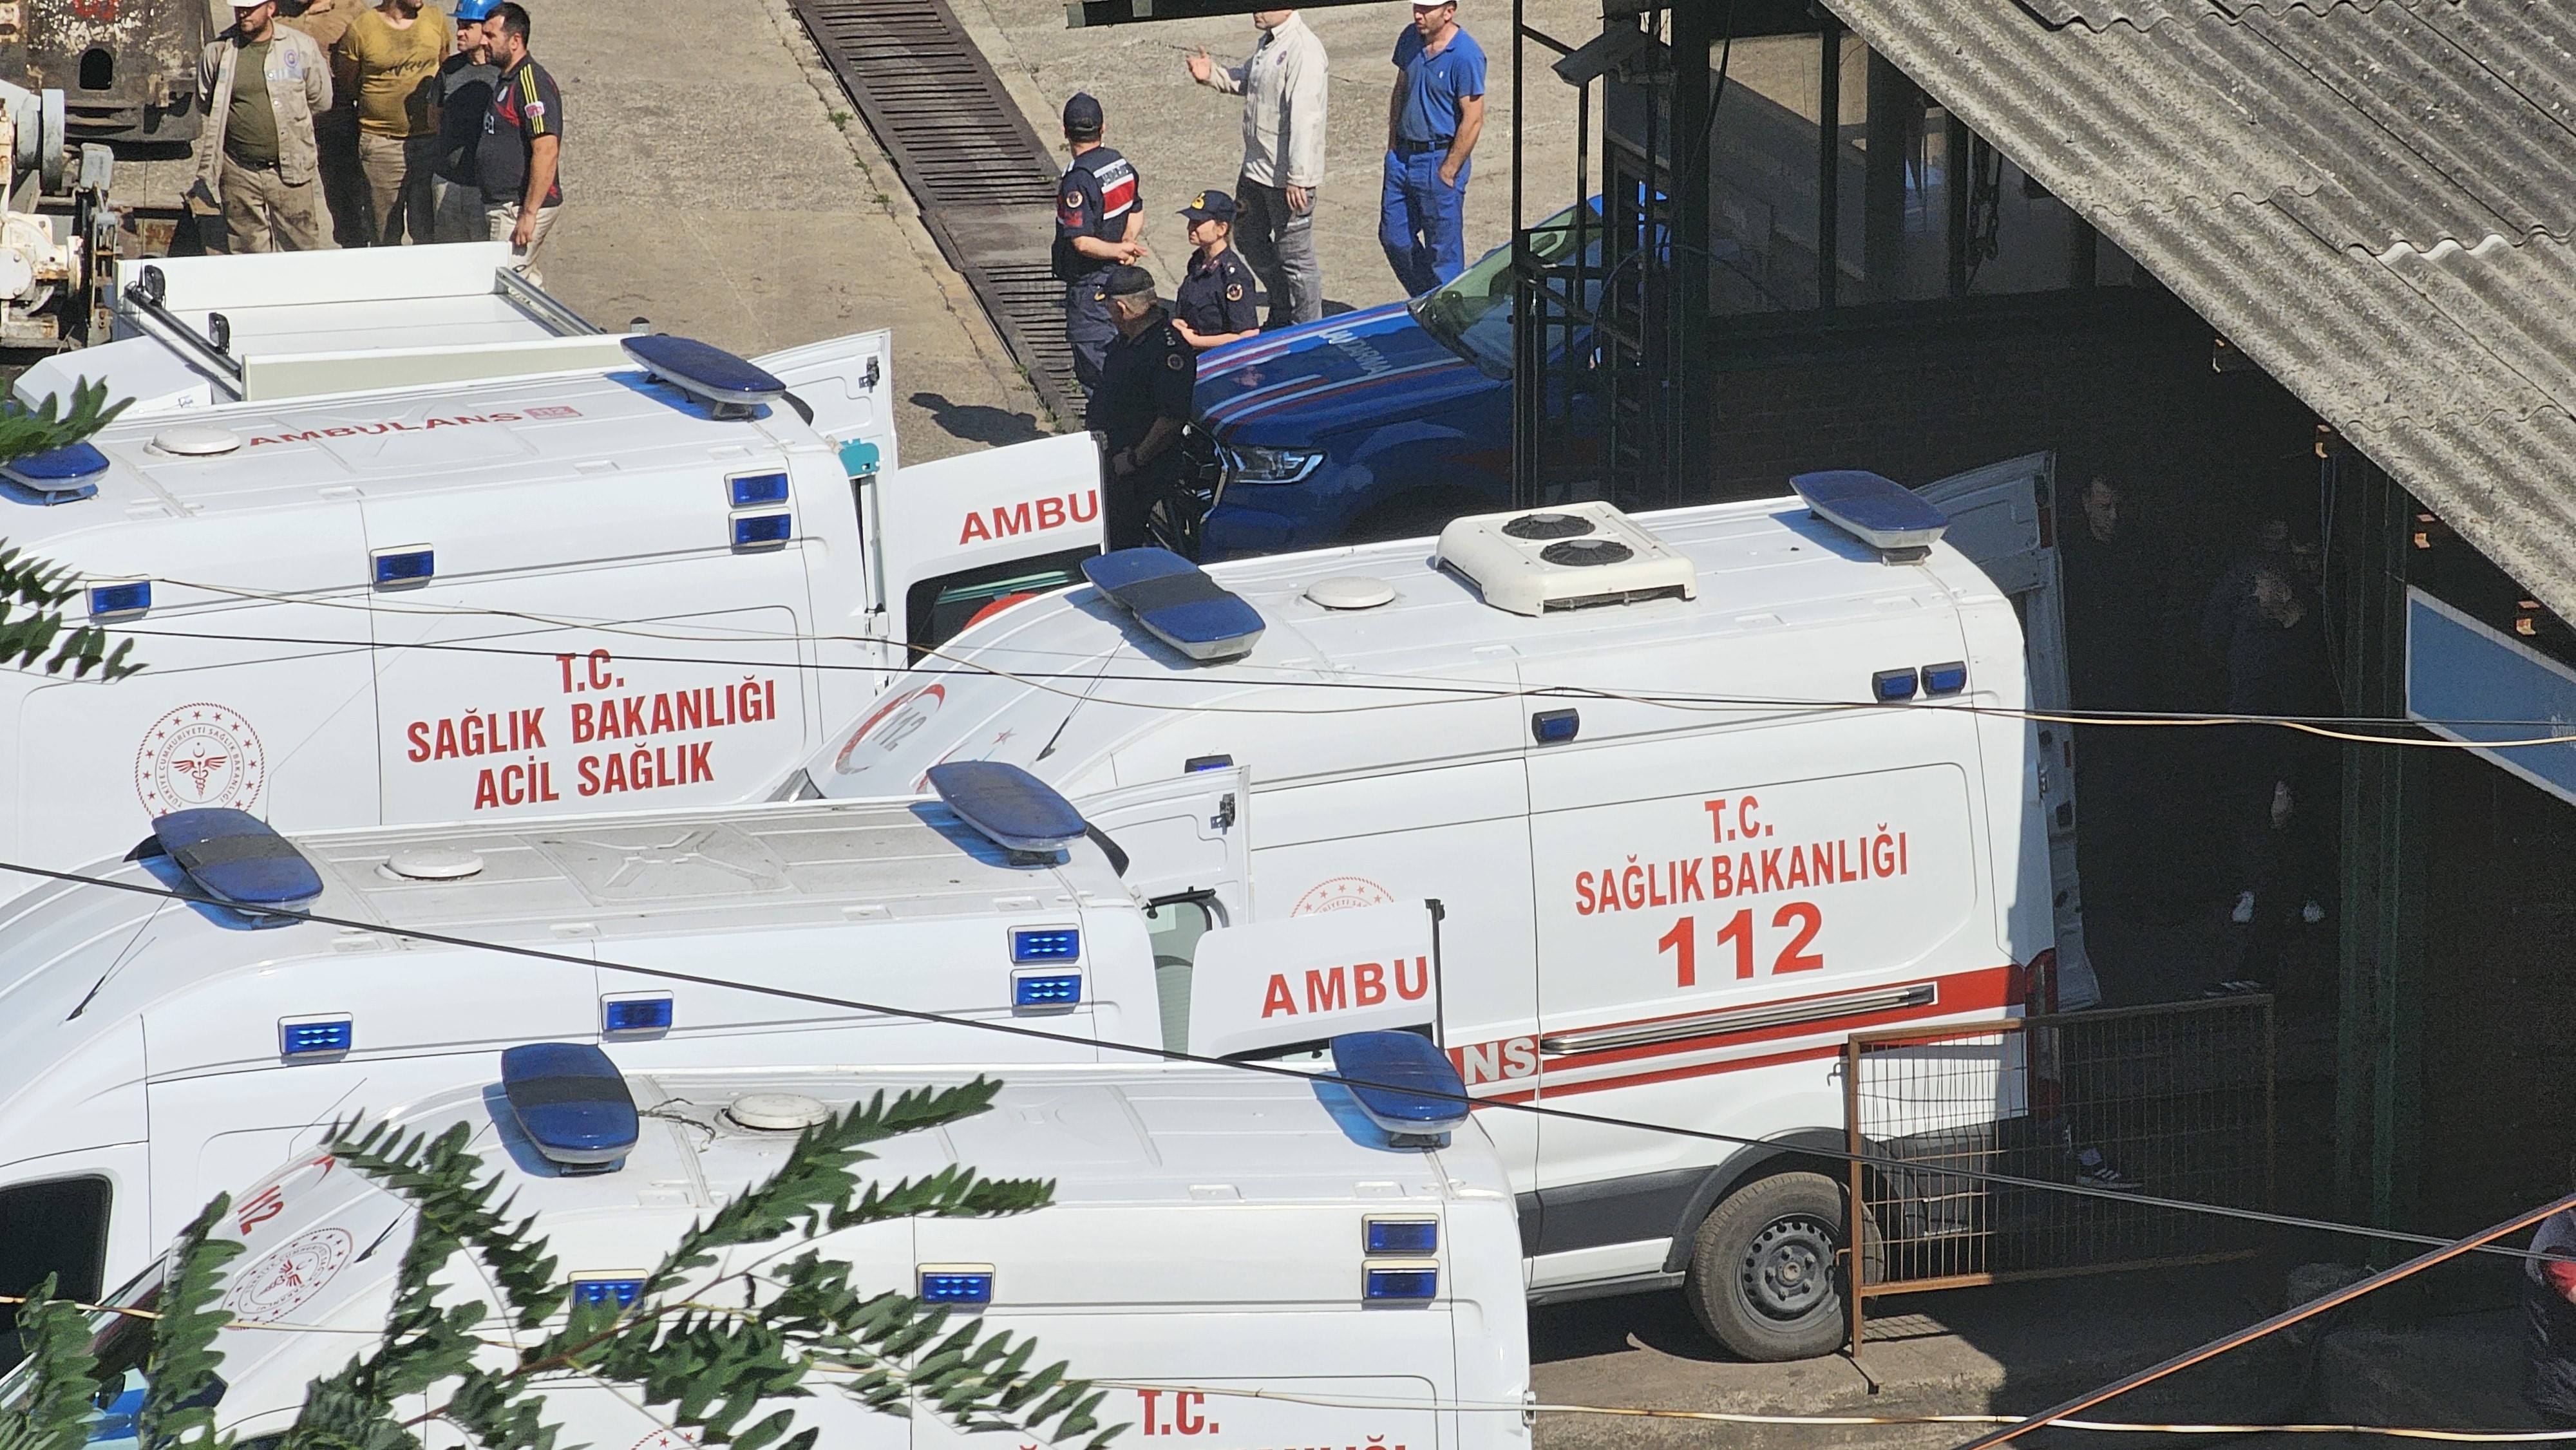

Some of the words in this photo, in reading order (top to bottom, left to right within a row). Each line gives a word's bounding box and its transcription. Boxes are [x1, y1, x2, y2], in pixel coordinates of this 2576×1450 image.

[250, 413, 523, 446] AMBULANS
[960, 489, 1099, 545] AMBU
[556, 648, 625, 693] T.C.
[209, 728, 236, 751] SAĞLIK
[408, 707, 545, 762] SAĞLIK
[571, 674, 775, 743] BAKANLIĞI
[474, 755, 558, 809] ACİL
[578, 740, 714, 796] SAĞLIK
[1704, 795, 1774, 843] T.C.
[1575, 854, 1705, 915] SAĞLIK
[1711, 824, 1908, 899] BAKANLIĞI
[1658, 901, 1824, 988] 112
[1261, 956, 1428, 1019] AMBU
[1462, 1037, 1537, 1086] NS
[237, 1183, 284, 1236] 112
[1137, 1388, 1220, 1436] T.C.
